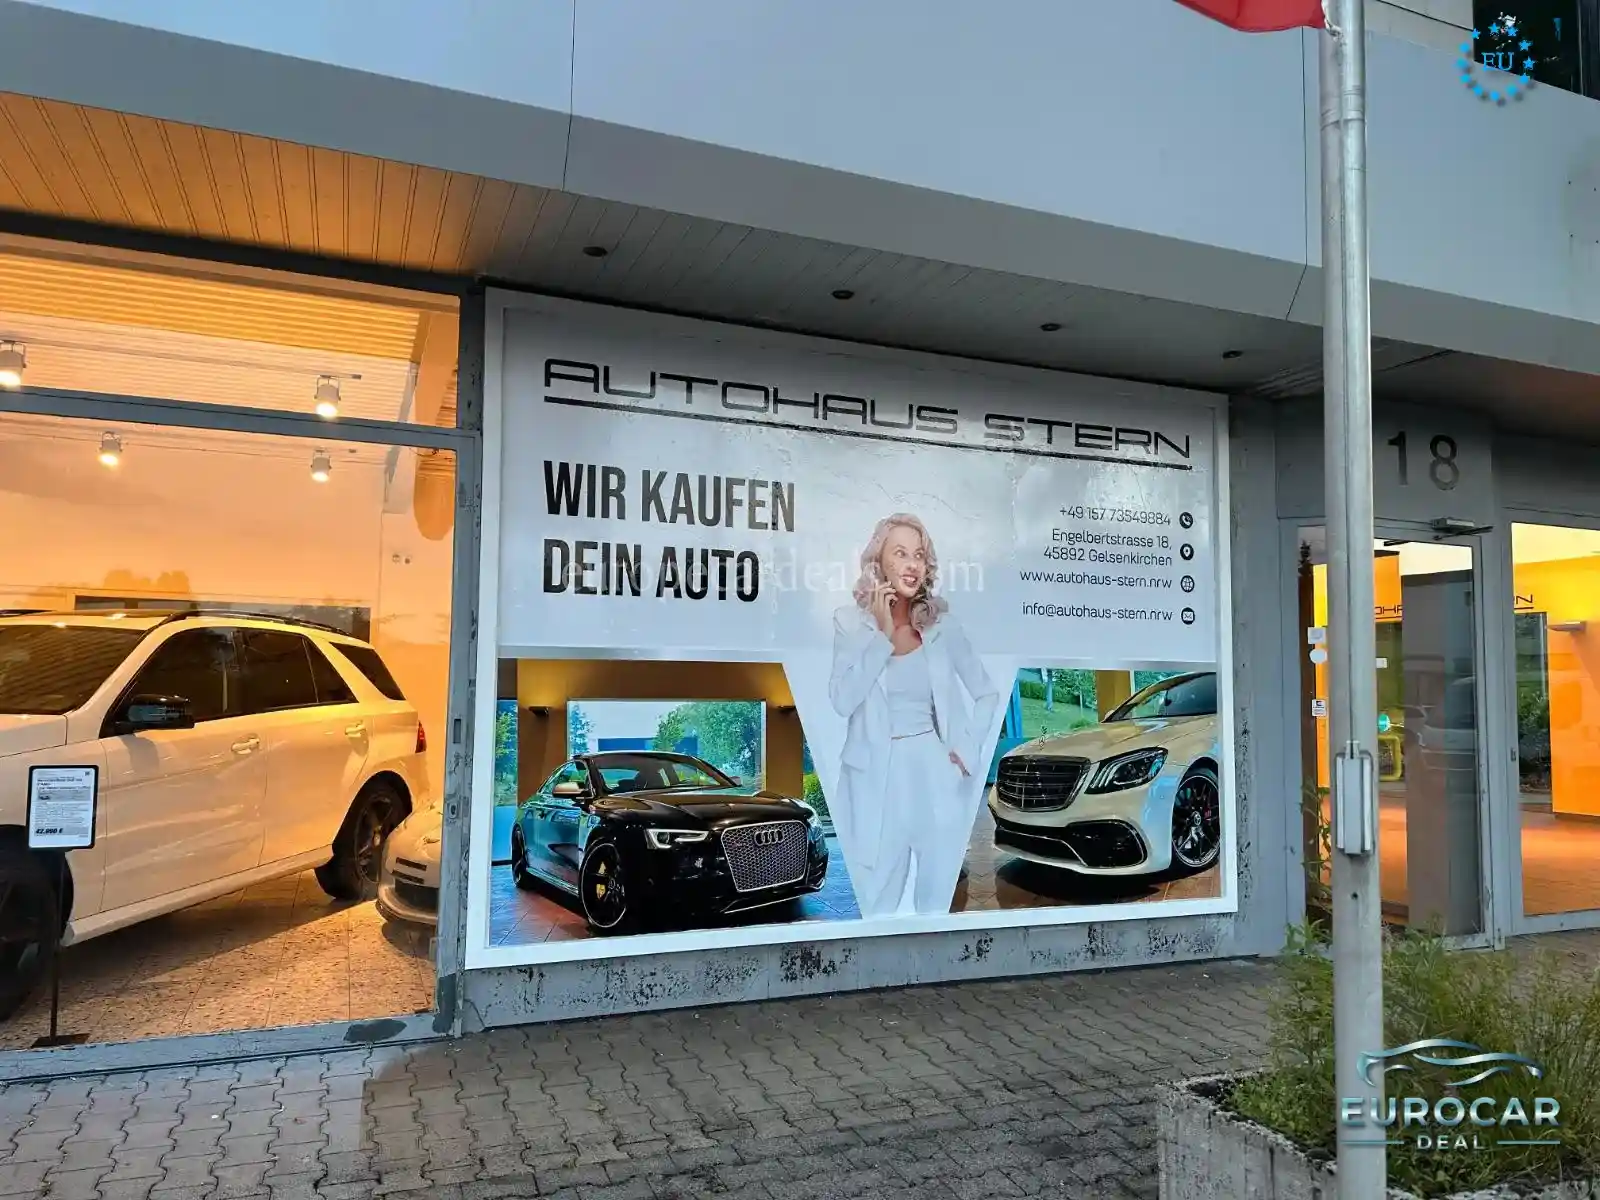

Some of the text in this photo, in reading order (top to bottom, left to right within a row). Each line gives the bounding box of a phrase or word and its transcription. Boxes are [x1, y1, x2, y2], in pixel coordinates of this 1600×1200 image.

[544, 358, 1190, 458] AUTOHAUS STERN
[1387, 430, 1460, 490] 18
[543, 460, 795, 532] WIR KAUFEN
[1060, 506, 1171, 525] +49 157 73549884
[1052, 528, 1172, 550] Engelbertstrasse 18,
[1043, 546, 1173, 566] 45892 Gelsenkirchen
[543, 538, 760, 602] DEIN AUTO
[1019, 570, 1173, 589] www.autohaus-stern.nrw
[1022, 602, 1173, 621] info@autohaus-stern.nrw
